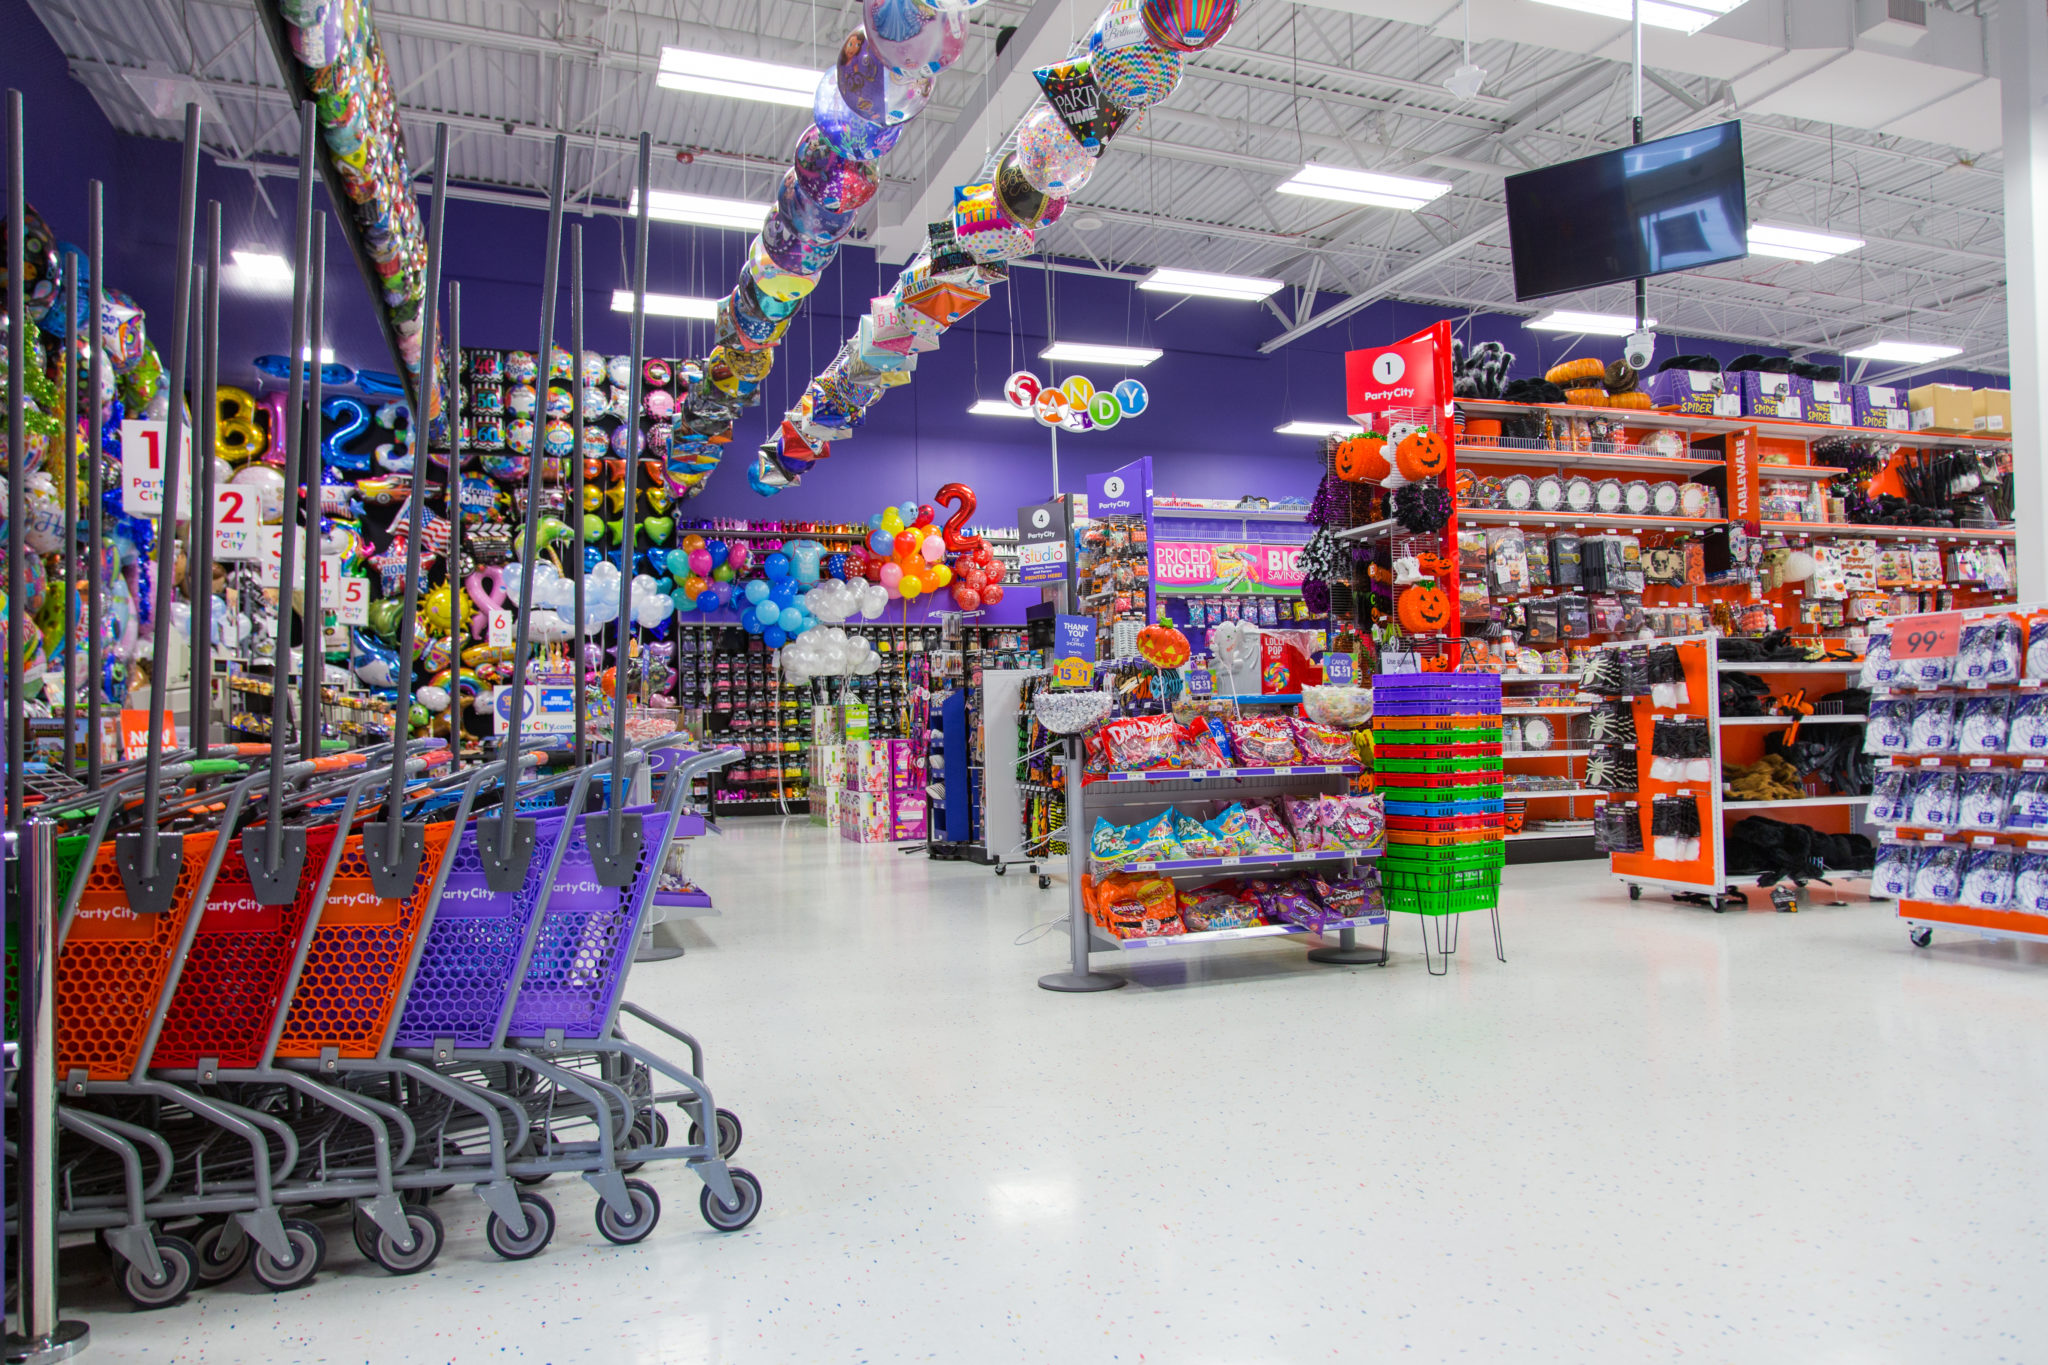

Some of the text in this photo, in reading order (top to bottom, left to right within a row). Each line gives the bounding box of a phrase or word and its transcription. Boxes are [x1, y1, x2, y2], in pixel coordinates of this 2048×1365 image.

[1104, 13, 1136, 31] HAPP
[1055, 85, 1101, 118] PARTY
[1066, 106, 1098, 124] TIME
[1386, 361, 1391, 375] 1
[1016, 379, 1139, 420] CANDY
[1681, 402, 1712, 414] SPIDER
[140, 431, 160, 469] 1
[133, 478, 164, 488] Part
[1735, 438, 1748, 516] TABLEWARE
[1111, 482, 1117, 492] 3
[139, 490, 164, 501] Cit
[219, 491, 244, 523] 2
[1038, 514, 1044, 523] 4
[216, 530, 247, 541] Party
[221, 539, 244, 550] City
[1025, 545, 1063, 564] studio
[1156, 548, 1211, 564] PRICED
[1157, 564, 1211, 579] RIGHT!
[345, 582, 361, 602] 5
[494, 615, 505, 629] 6
[1064, 623, 1089, 632] THANK
[1069, 630, 1084, 638] YOU
[1267, 646, 1283, 655] POP
[1060, 668, 1072, 680] 15
